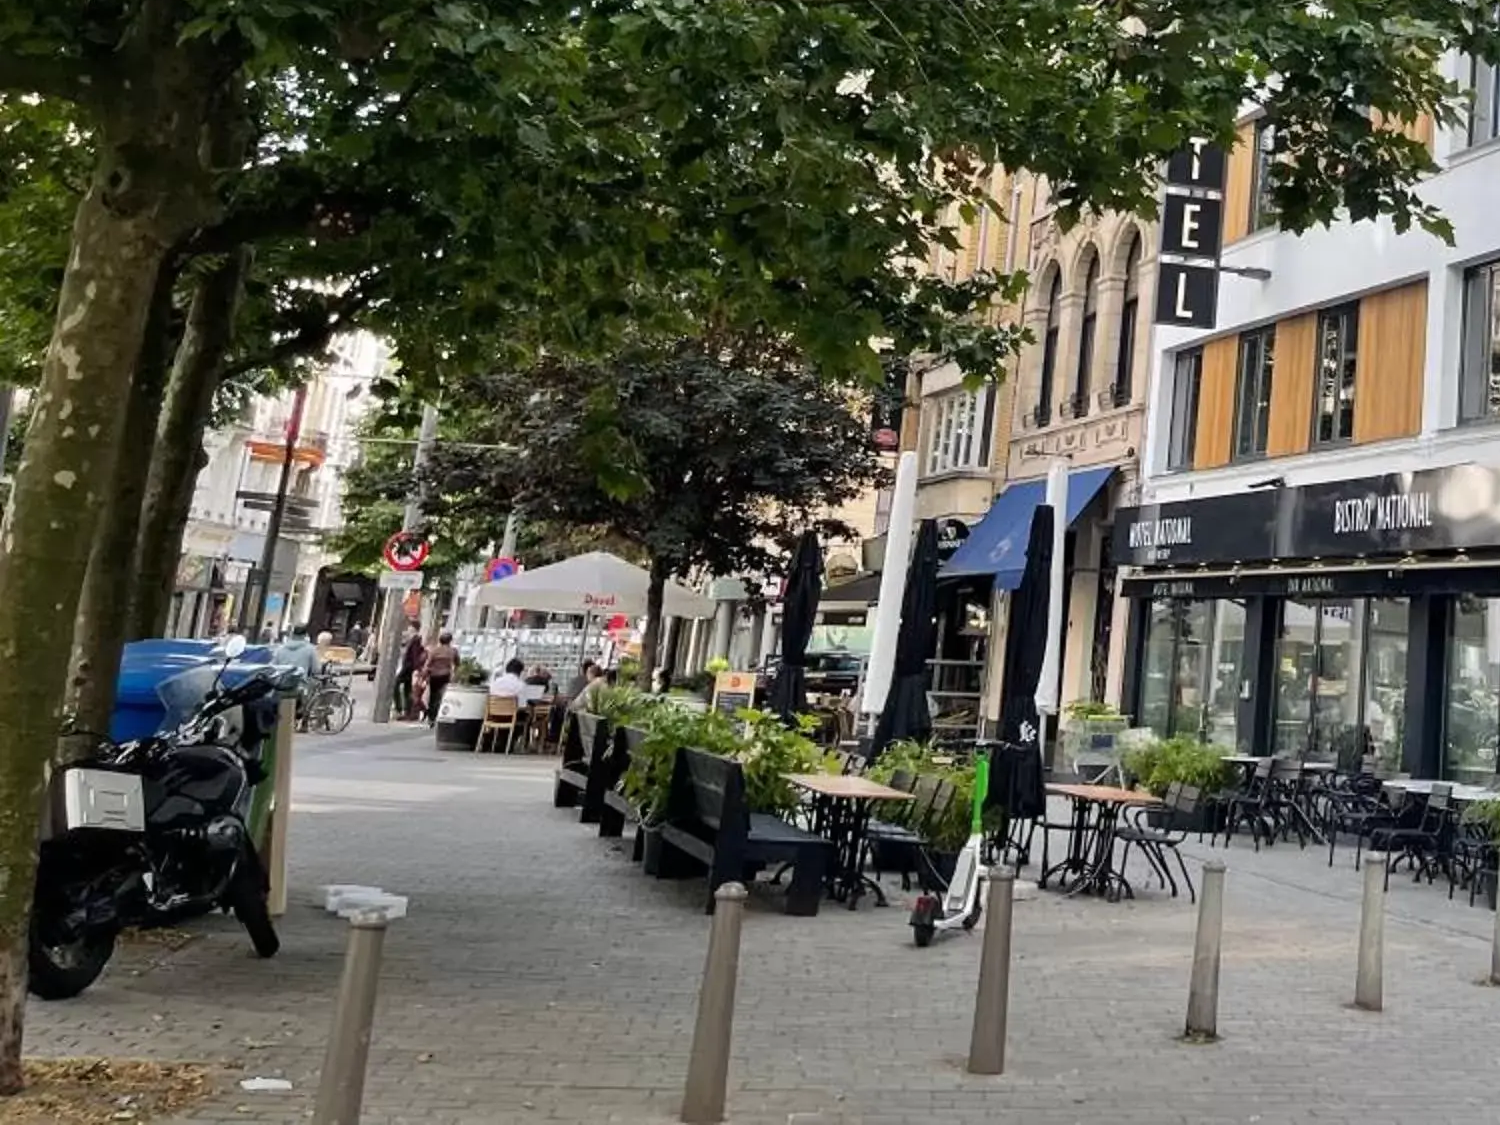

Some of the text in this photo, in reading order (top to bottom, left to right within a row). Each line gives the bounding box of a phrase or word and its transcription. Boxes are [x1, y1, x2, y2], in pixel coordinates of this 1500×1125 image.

[1175, 136, 1209, 319] TEL
[1334, 492, 1433, 534] BISTRO NATIONAL
